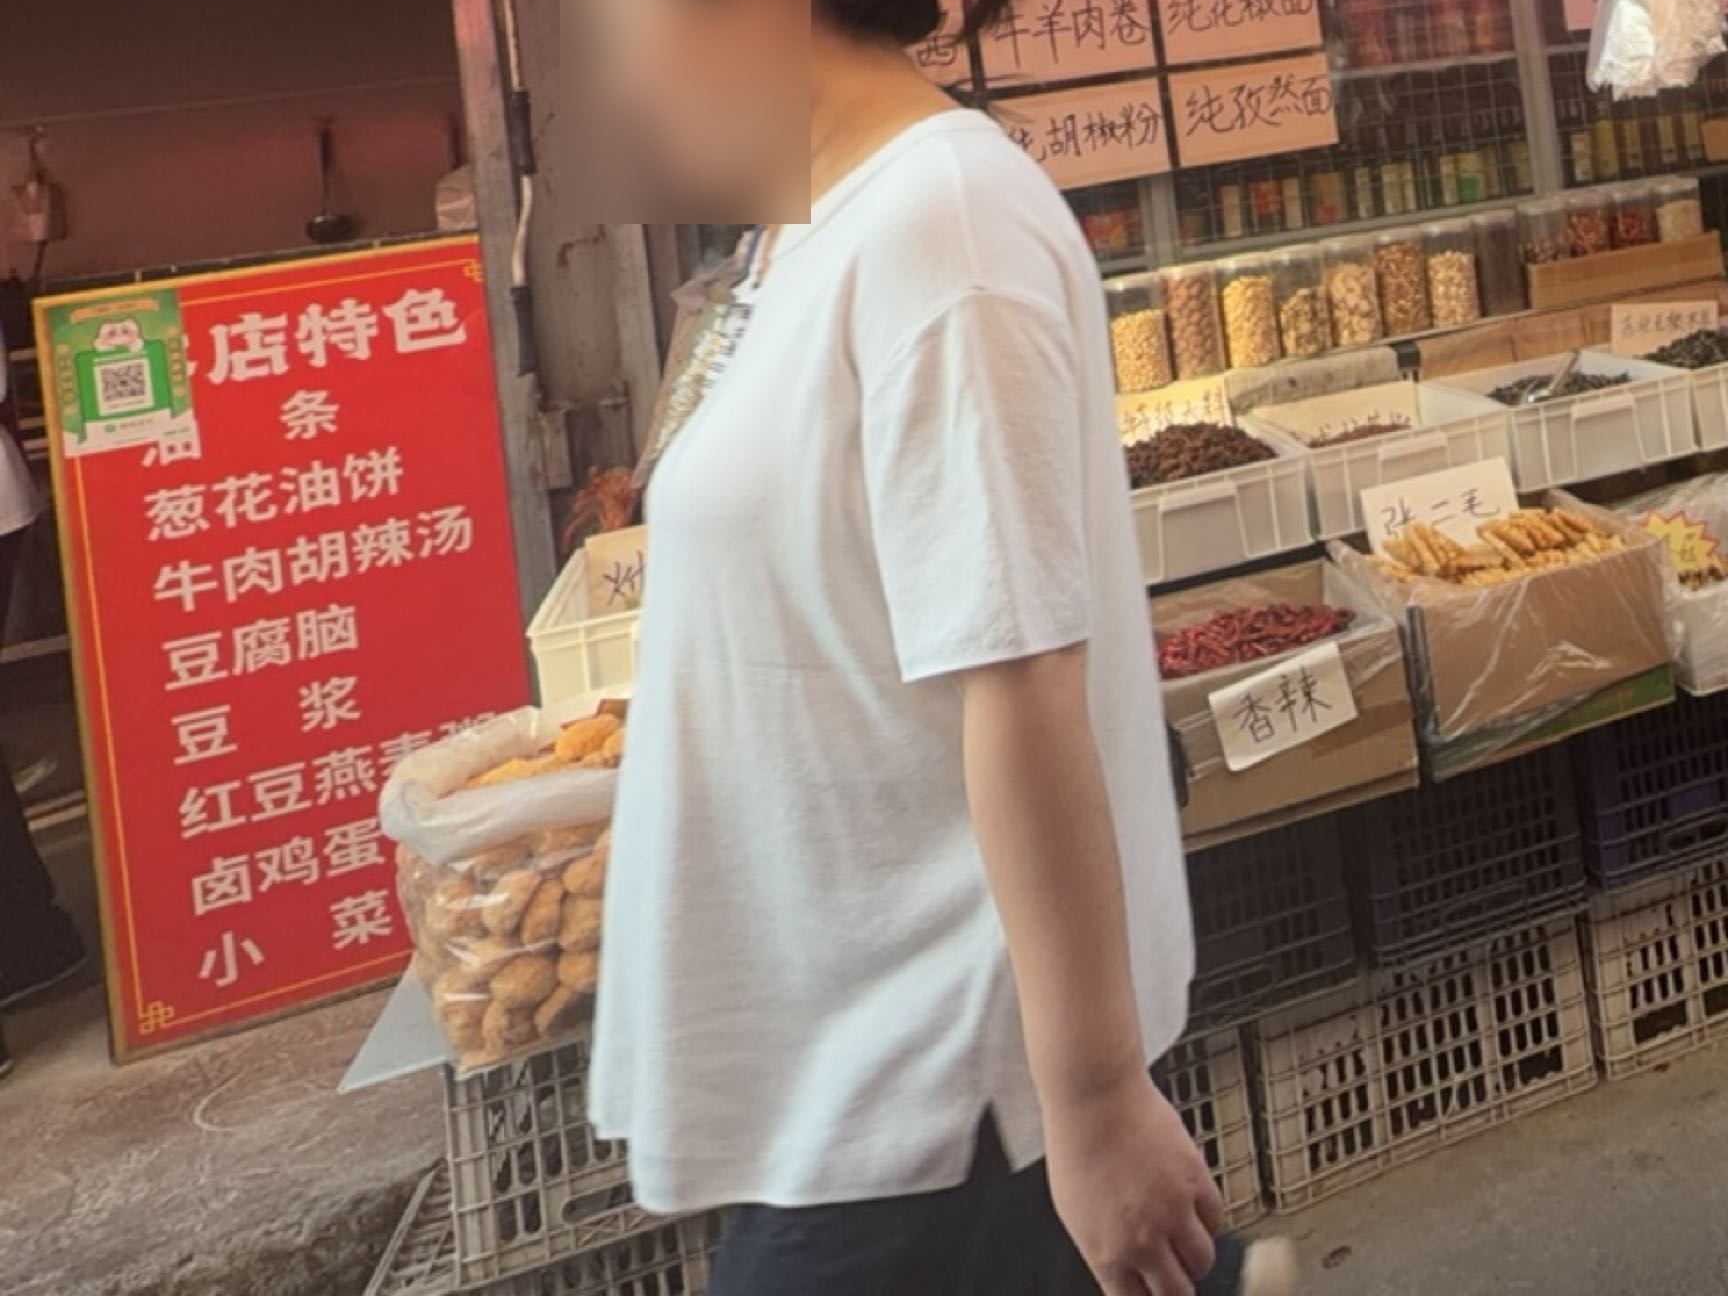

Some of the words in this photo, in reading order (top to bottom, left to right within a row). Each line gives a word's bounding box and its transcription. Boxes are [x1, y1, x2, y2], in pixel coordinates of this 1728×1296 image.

[1186, 73, 1332, 137] 纯孜然面
[184, 287, 468, 384] 店特色
[279, 389, 340, 440] 条
[143, 446, 403, 542] 葱花油饼
[153, 505, 473, 613] 牛肉胡辣汤
[163, 603, 359, 691] 豆腐脑
[171, 705, 238, 765] 豆
[298, 676, 361, 733] 浆
[1232, 664, 1333, 744] 香辣
[179, 711, 500, 839] 红豆燕麦
[192, 816, 385, 916] 卤鸡蛋
